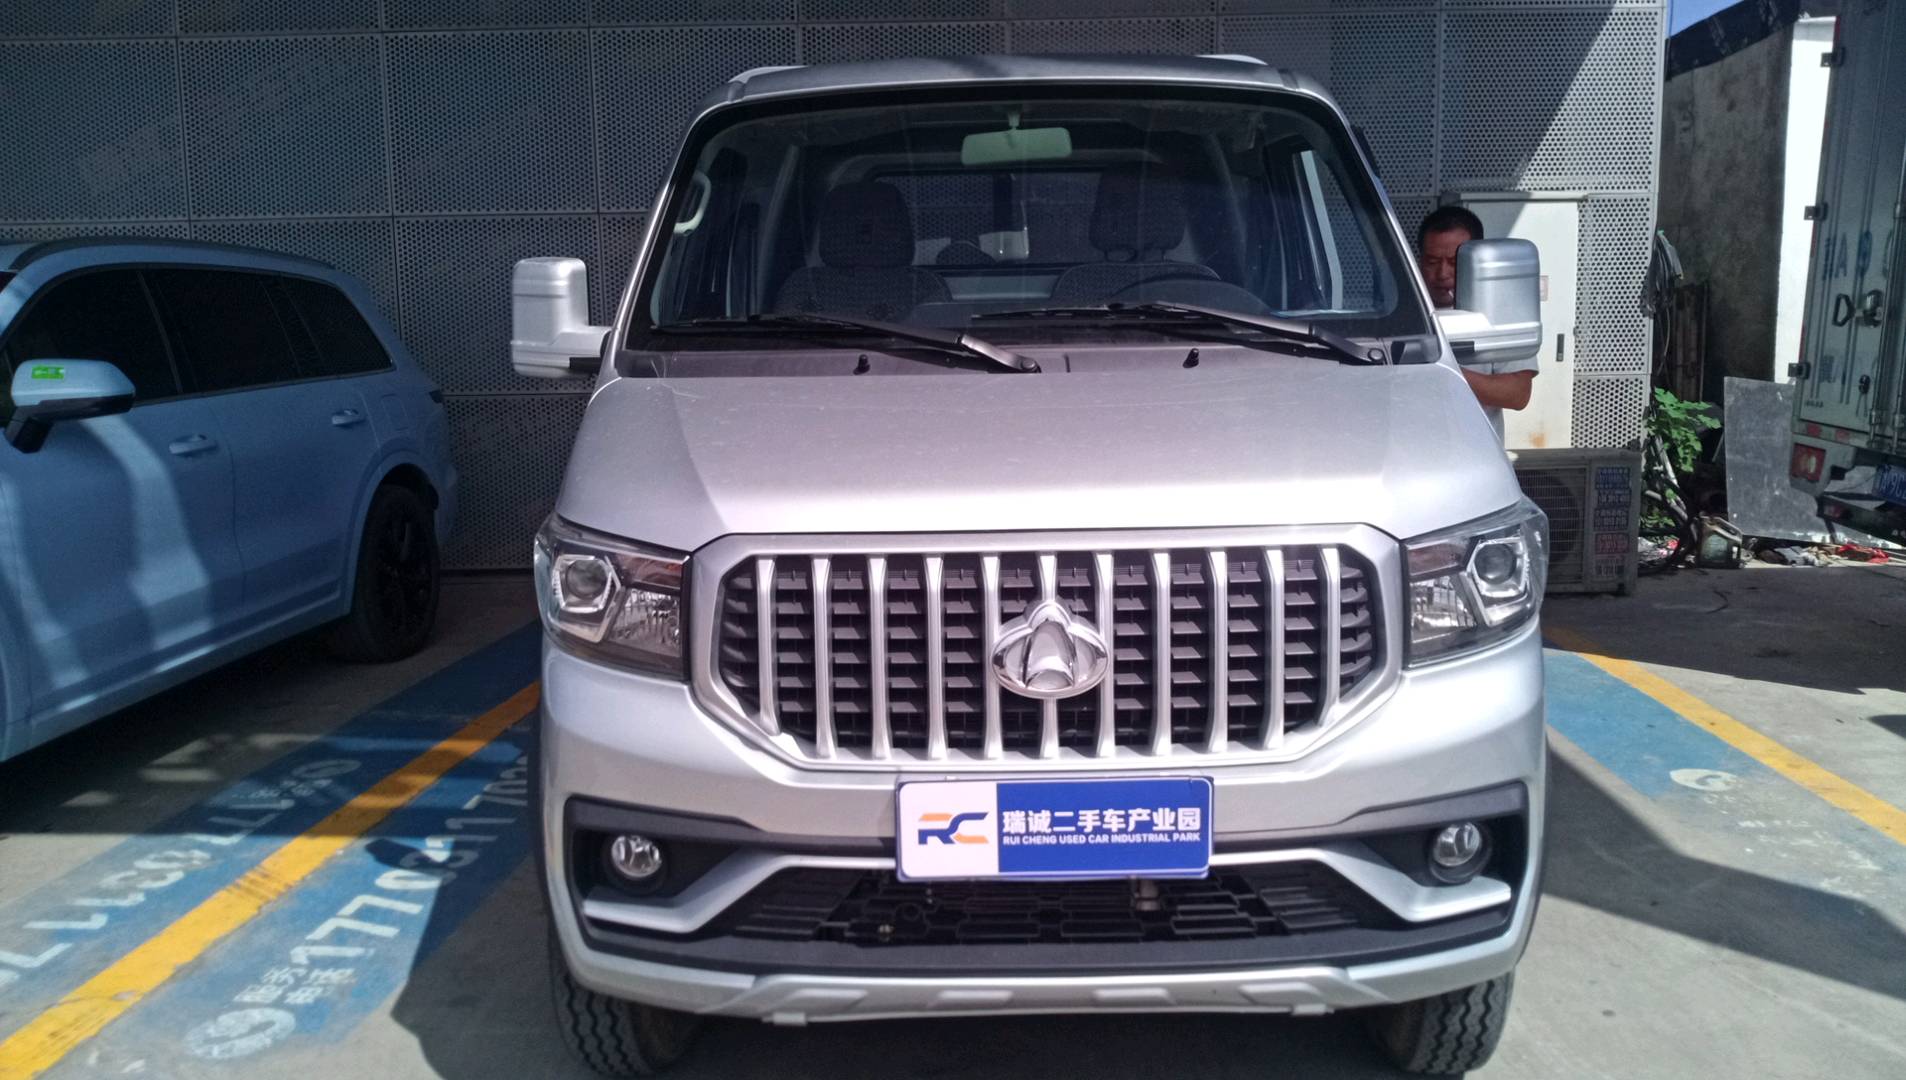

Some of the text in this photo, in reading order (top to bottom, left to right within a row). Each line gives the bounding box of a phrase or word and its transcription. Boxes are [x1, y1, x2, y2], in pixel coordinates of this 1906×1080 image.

[918, 812, 989, 845] RC
[1002, 807, 1201, 834] 瑞诚二手车产业园
[1003, 832, 1200, 845] RUI CHENG USED CAR INDUSTRIAL PARK
